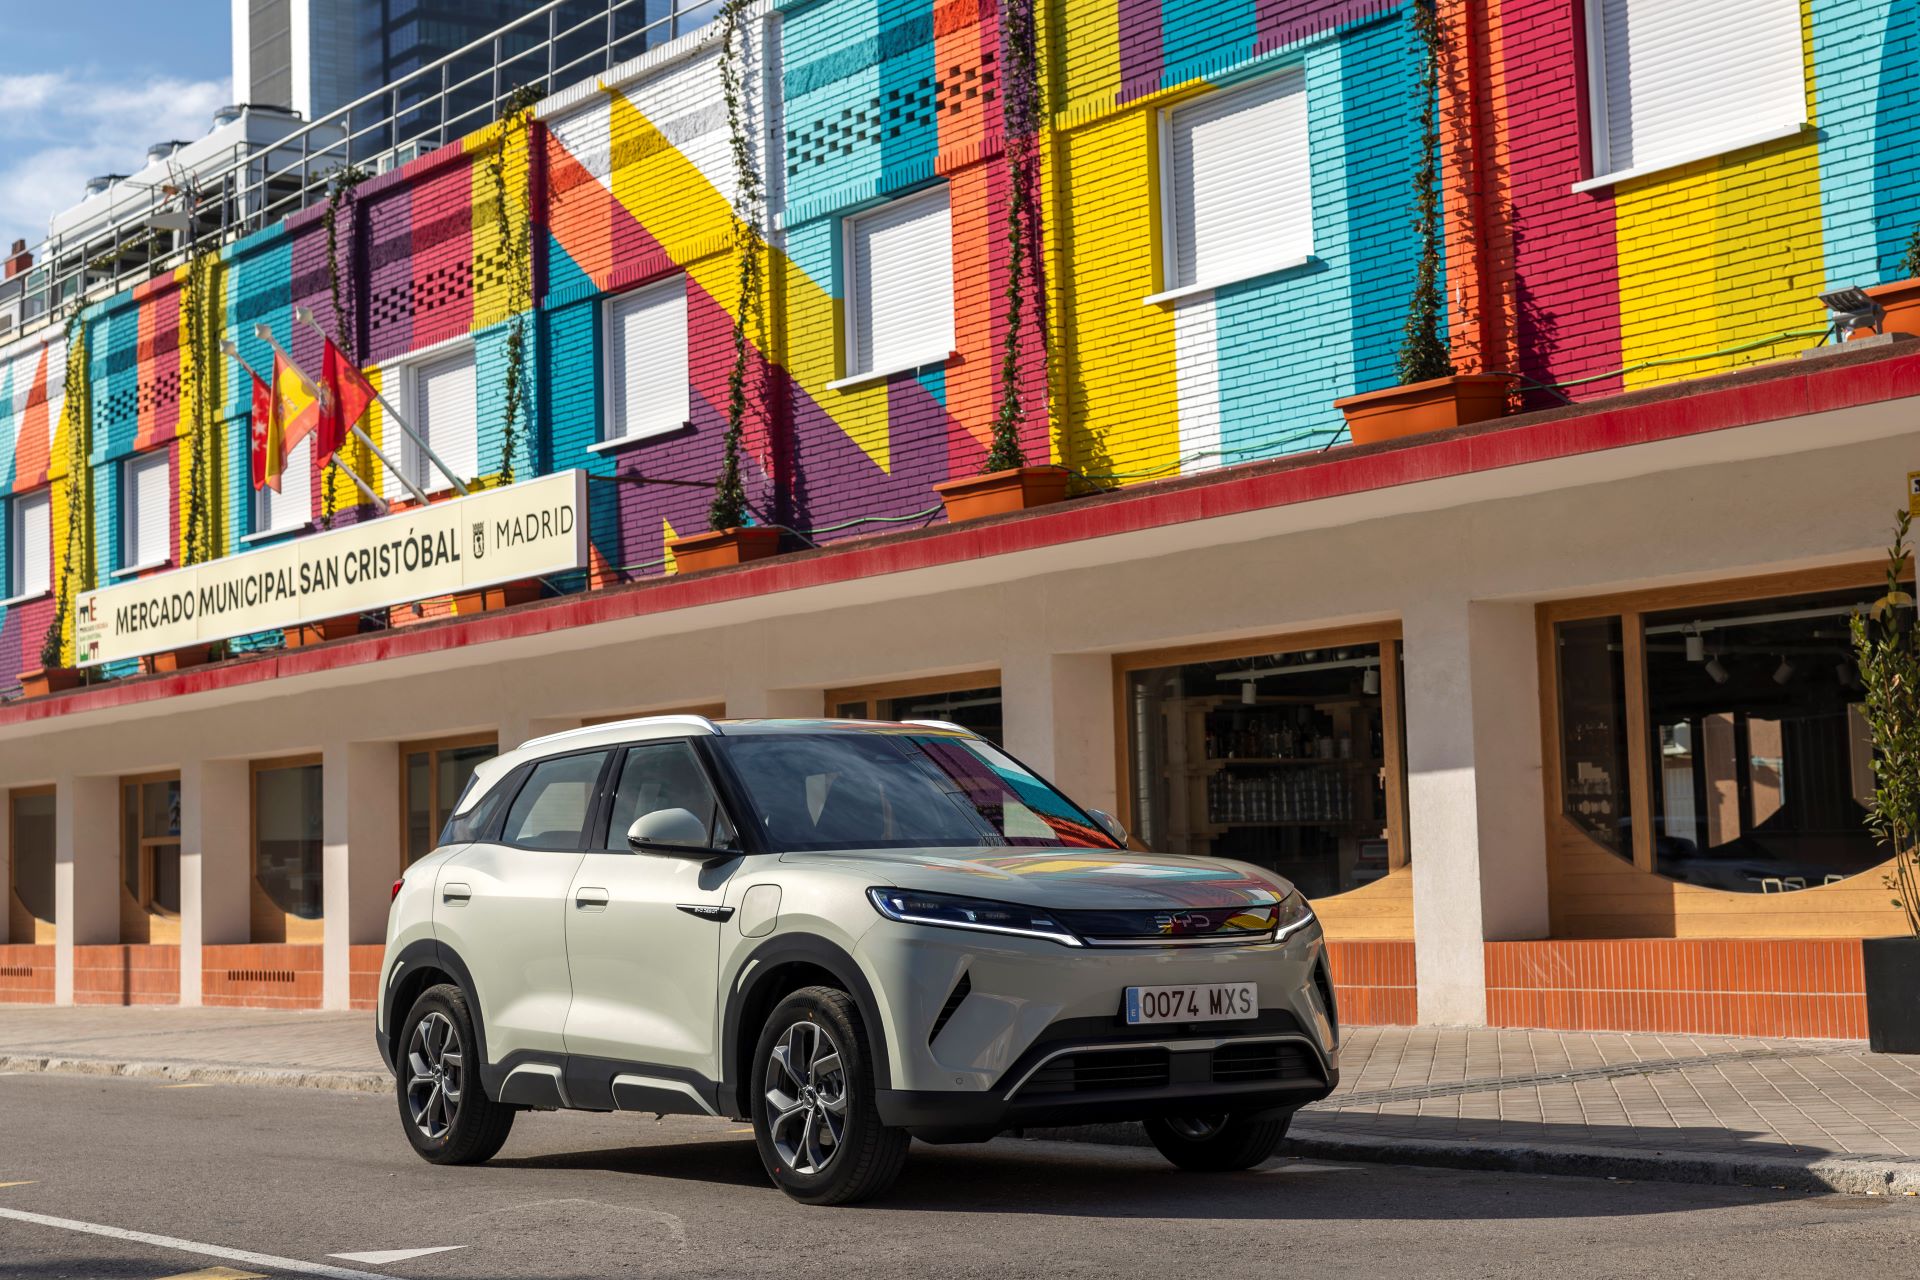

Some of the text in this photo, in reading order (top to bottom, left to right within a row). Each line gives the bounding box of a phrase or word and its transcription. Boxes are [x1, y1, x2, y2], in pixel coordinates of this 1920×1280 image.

[496, 504, 574, 550] MADRID
[116, 528, 461, 636] MERCADO MUNICIPAL SAN CRISTÓBAL
[1154, 911, 1210, 928] BYD
[1142, 990, 1199, 1018] 0074
[1209, 988, 1251, 1015] MXS
